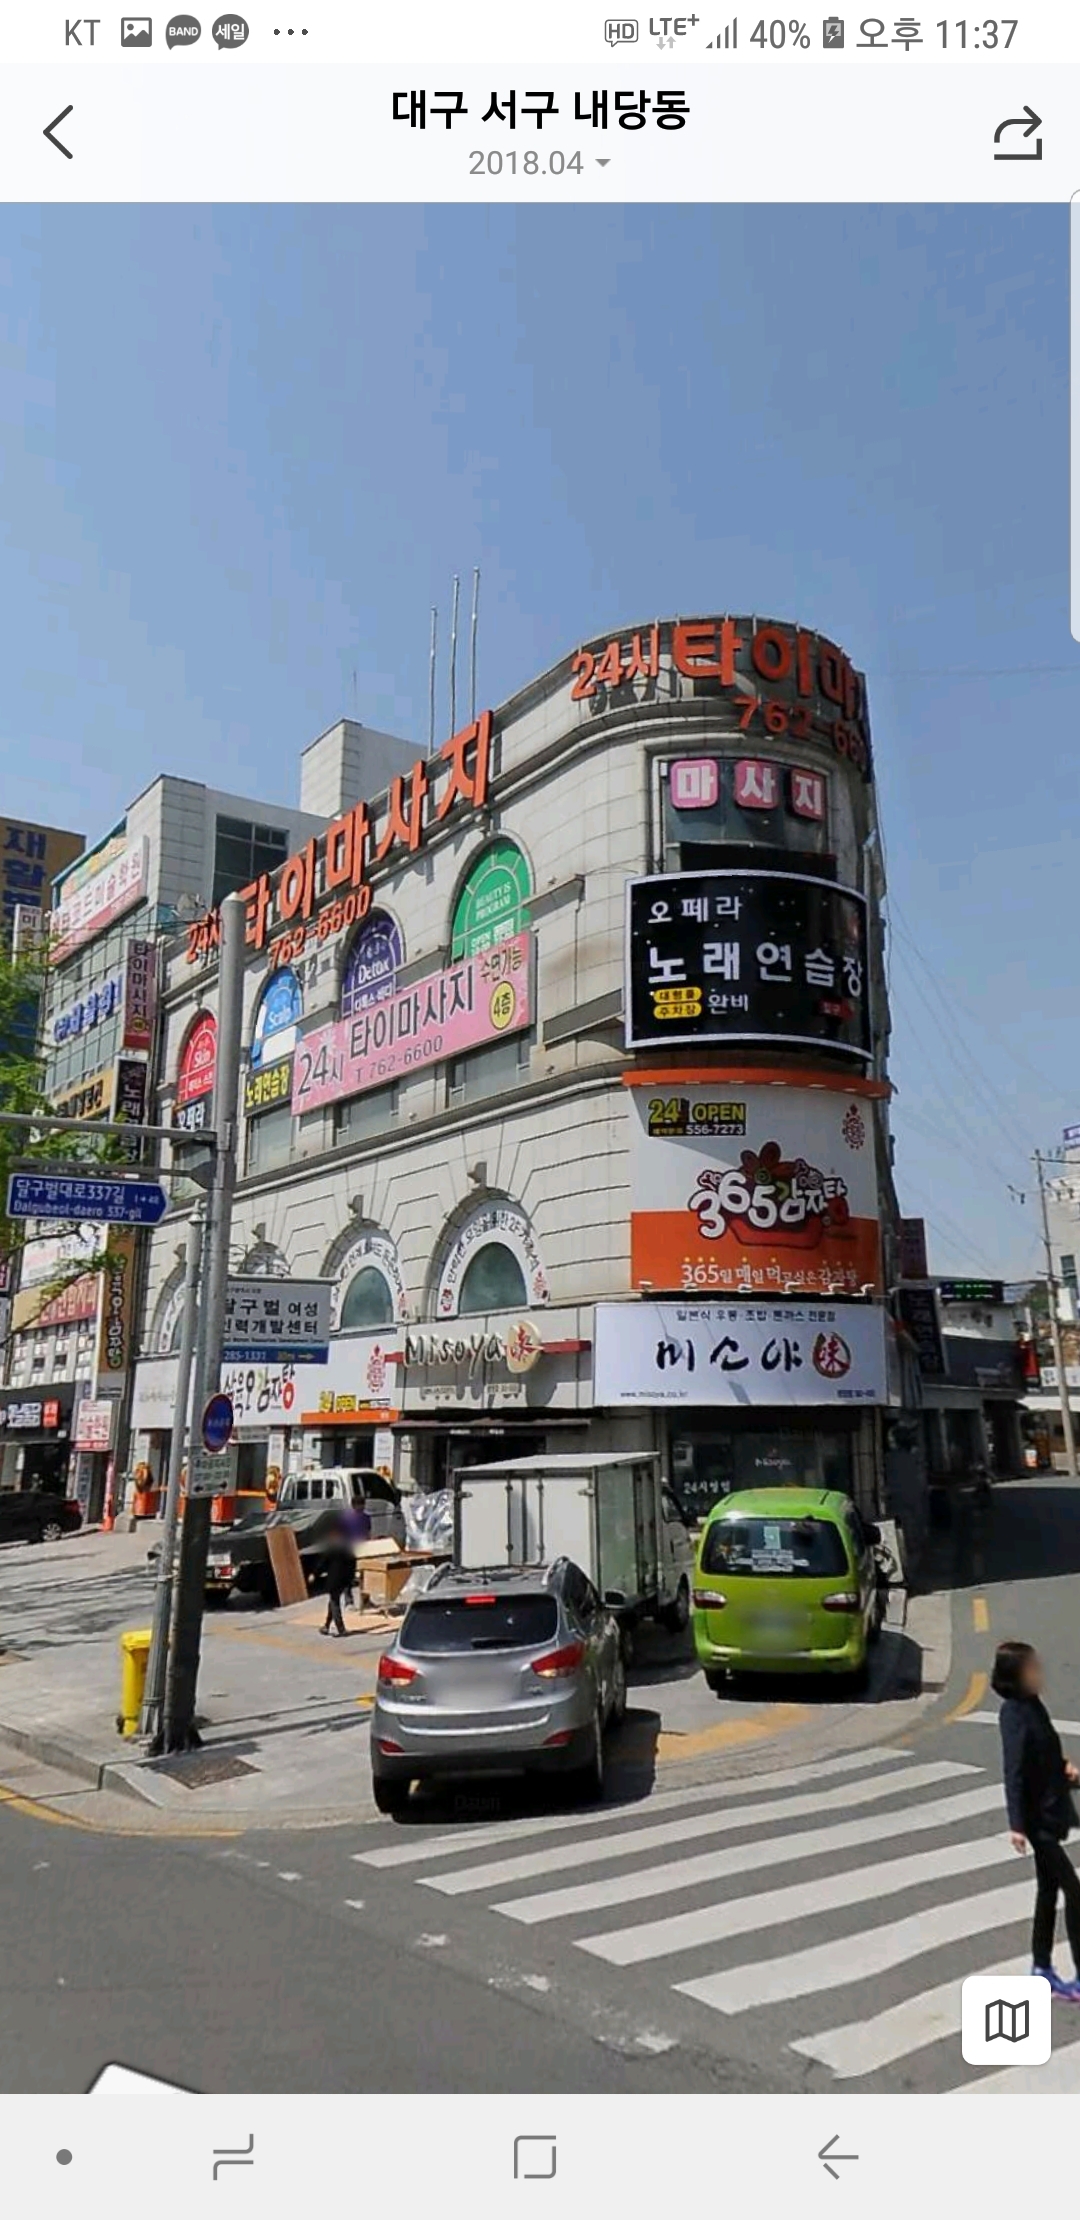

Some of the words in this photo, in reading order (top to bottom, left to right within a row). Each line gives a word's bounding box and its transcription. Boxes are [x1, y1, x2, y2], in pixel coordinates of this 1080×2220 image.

[571, 629, 659, 699] 24시
[676, 765, 822, 815] 마사지
[239, 710, 494, 949] 타이마사지
[647, 895, 743, 924] 오페라
[269, 885, 373, 968] 762-6600
[358, 959, 391, 985] Detox
[647, 941, 863, 998] 노래연습장
[350, 965, 476, 1060] 타이마사지
[659, 1004, 696, 1018] 주차장
[708, 993, 749, 1015] 완비
[368, 1034, 444, 1082] 762-6600
[299, 1048, 345, 1098] 24시
[693, 1103, 745, 1122] OPEN
[685, 1123, 745, 1136] 556-7273
[15, 1178, 126, 1205] 달구벌대로337길
[13, 1200, 103, 1218] Dalgubeol-daero
[106, 1206, 142, 1220] 337-gil
[681, 1264, 734, 1285] 365일
[287, 1301, 319, 1318] 여성
[676, 1309, 711, 1322] 일본식
[807, 1310, 836, 1323] 전문점
[403, 1332, 505, 1380] Misoya
[655, 1334, 804, 1373] 미소야
